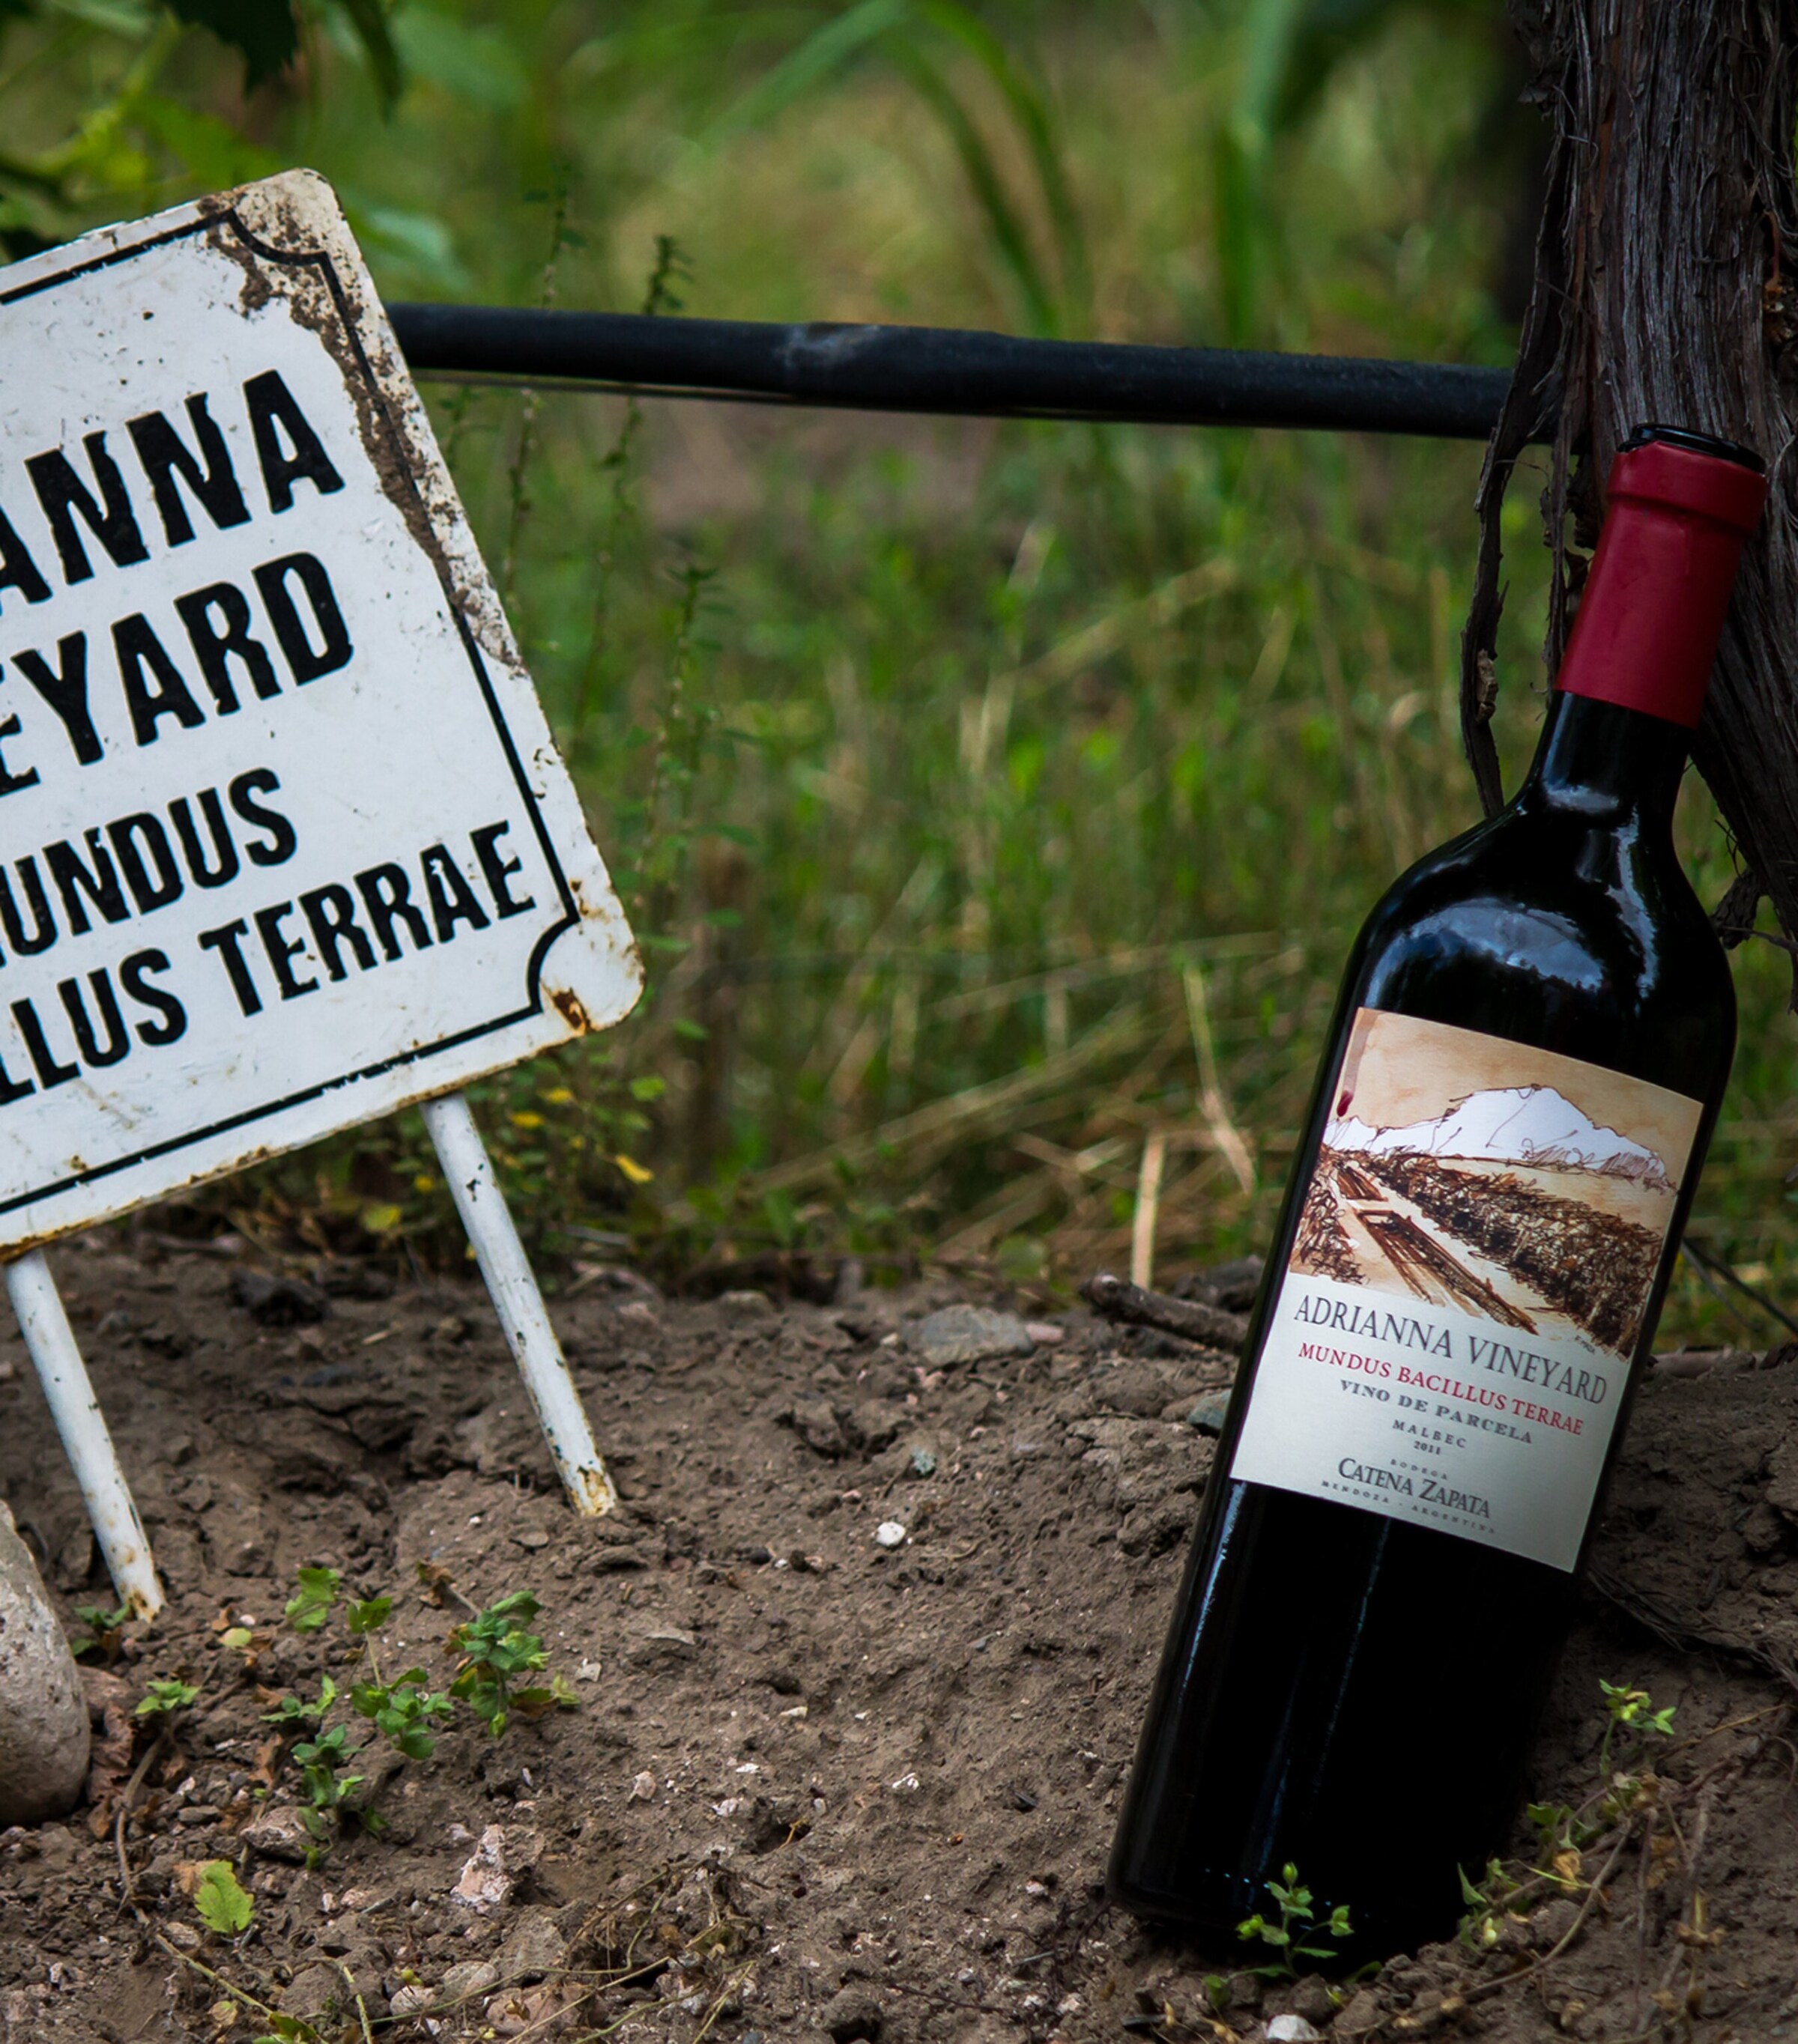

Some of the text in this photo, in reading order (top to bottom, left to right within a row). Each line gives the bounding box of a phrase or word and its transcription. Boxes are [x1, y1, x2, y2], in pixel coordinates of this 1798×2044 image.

[0, 553, 353, 797] YARD
[0, 768, 296, 968] UNDUS
[199, 820, 536, 1016] TERRAE
[1294, 1294, 1607, 1404] ADRIANNA VINEYARD
[1298, 1343, 1583, 1436] MUNDUS BACILLUS TERRAE
[1340, 1380, 1532, 1444] VINO DE PARCELA
[1392, 1419, 1467, 1449] MALBEC
[1414, 1440, 1442, 1455] 2011
[1390, 1459, 1448, 1480] CATENA
